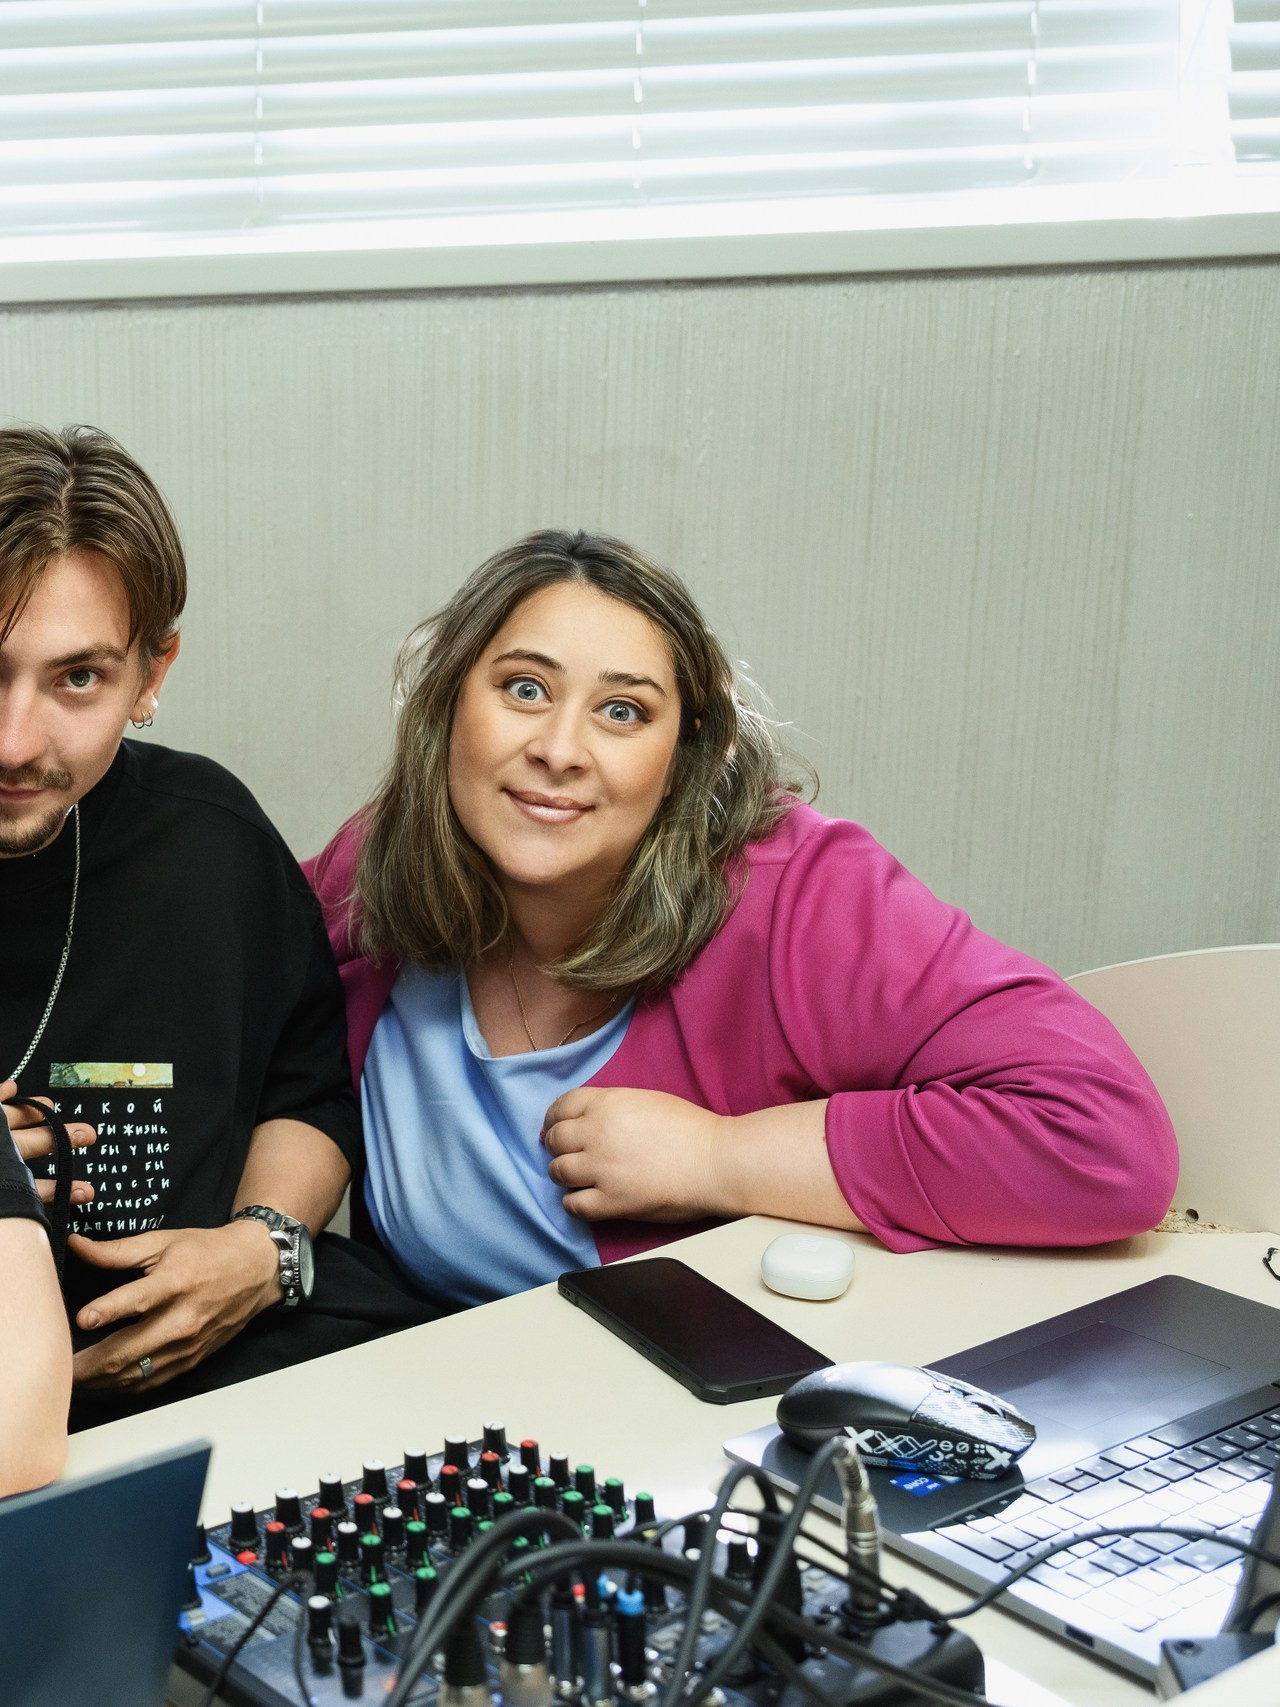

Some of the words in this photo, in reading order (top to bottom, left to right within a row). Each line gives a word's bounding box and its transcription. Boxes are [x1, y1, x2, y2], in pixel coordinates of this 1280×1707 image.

[54, 1098, 163, 1114] КАКОЙ
[97, 1123, 116, 1135] БЫ
[100, 1144, 119, 1155] БЫ
[147, 1143, 170, 1154] НАС
[86, 1162, 128, 1174] БЫЛО
[145, 1160, 164, 1171] БЫ
[85, 1177, 170, 1191] ЛОСТИ
[67, 1214, 164, 1232] ЕДПРИНЯТЬ!
